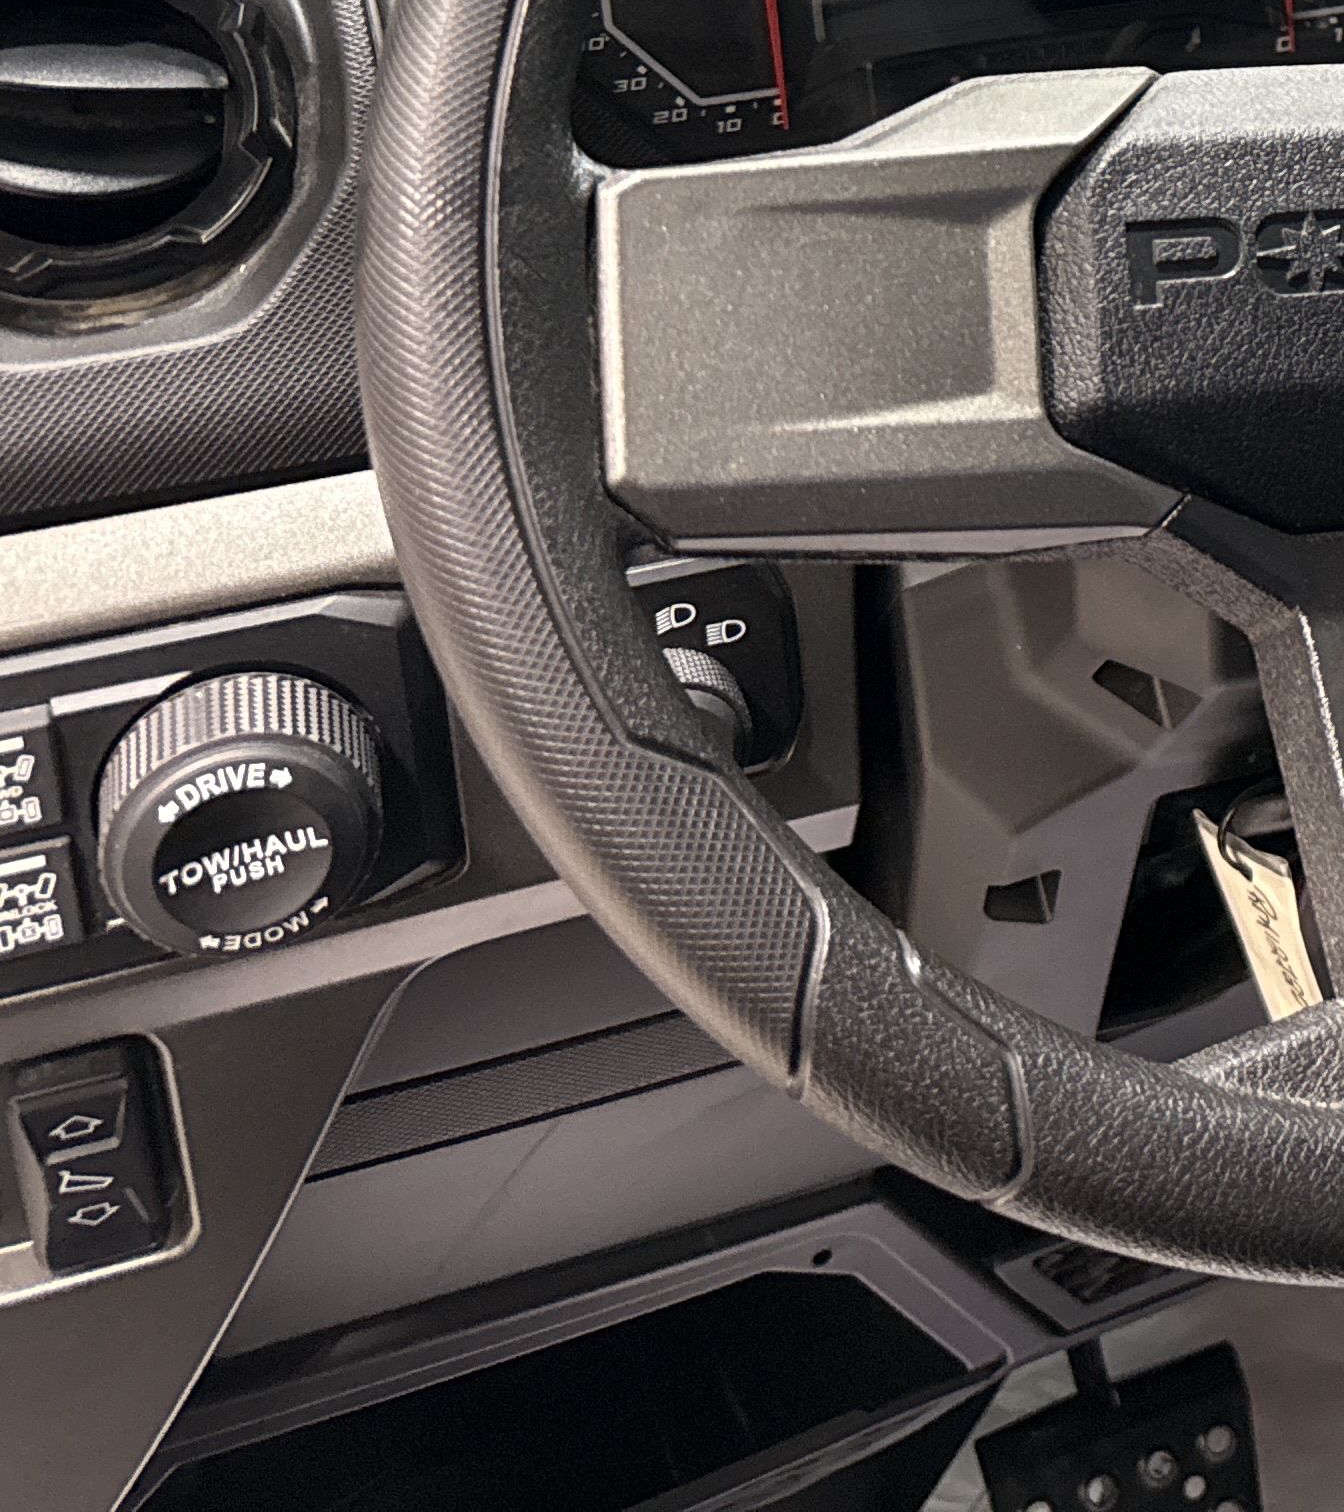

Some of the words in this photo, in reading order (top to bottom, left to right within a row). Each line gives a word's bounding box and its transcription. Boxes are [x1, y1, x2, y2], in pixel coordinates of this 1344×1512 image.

[1275, 35, 1293, 54] 0
[1334, 27, 1343, 43] 1
[613, 76, 648, 93] 30
[652, 108, 688, 125] 20
[716, 118, 742, 134] 10
[174, 762, 266, 811] DRIVE
[158, 826, 329, 896] TOW/HAUL
[212, 854, 285, 894] PUSH
[221, 909, 310, 953] MODE
